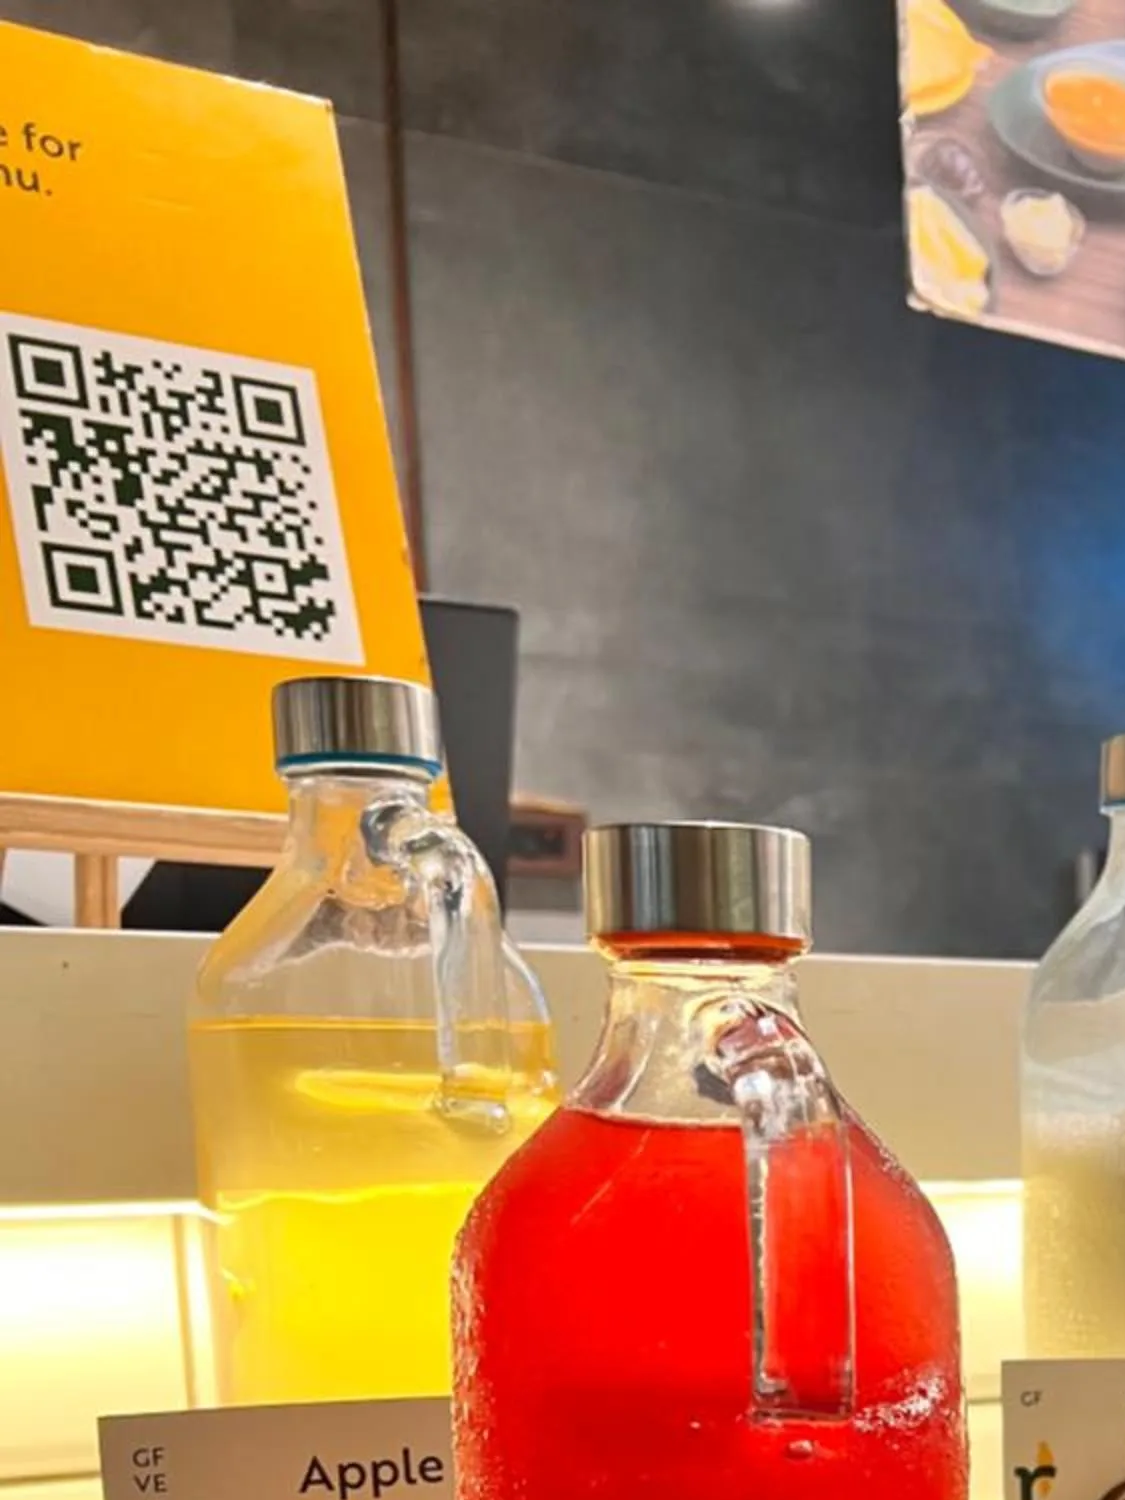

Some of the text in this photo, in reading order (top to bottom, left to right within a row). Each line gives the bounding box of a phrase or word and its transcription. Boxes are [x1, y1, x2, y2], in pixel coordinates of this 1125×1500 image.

[23, 121, 82, 162] for
[132, 1447, 164, 1468] GF
[133, 1474, 168, 1493] VE
[299, 1447, 444, 1500] Apple
